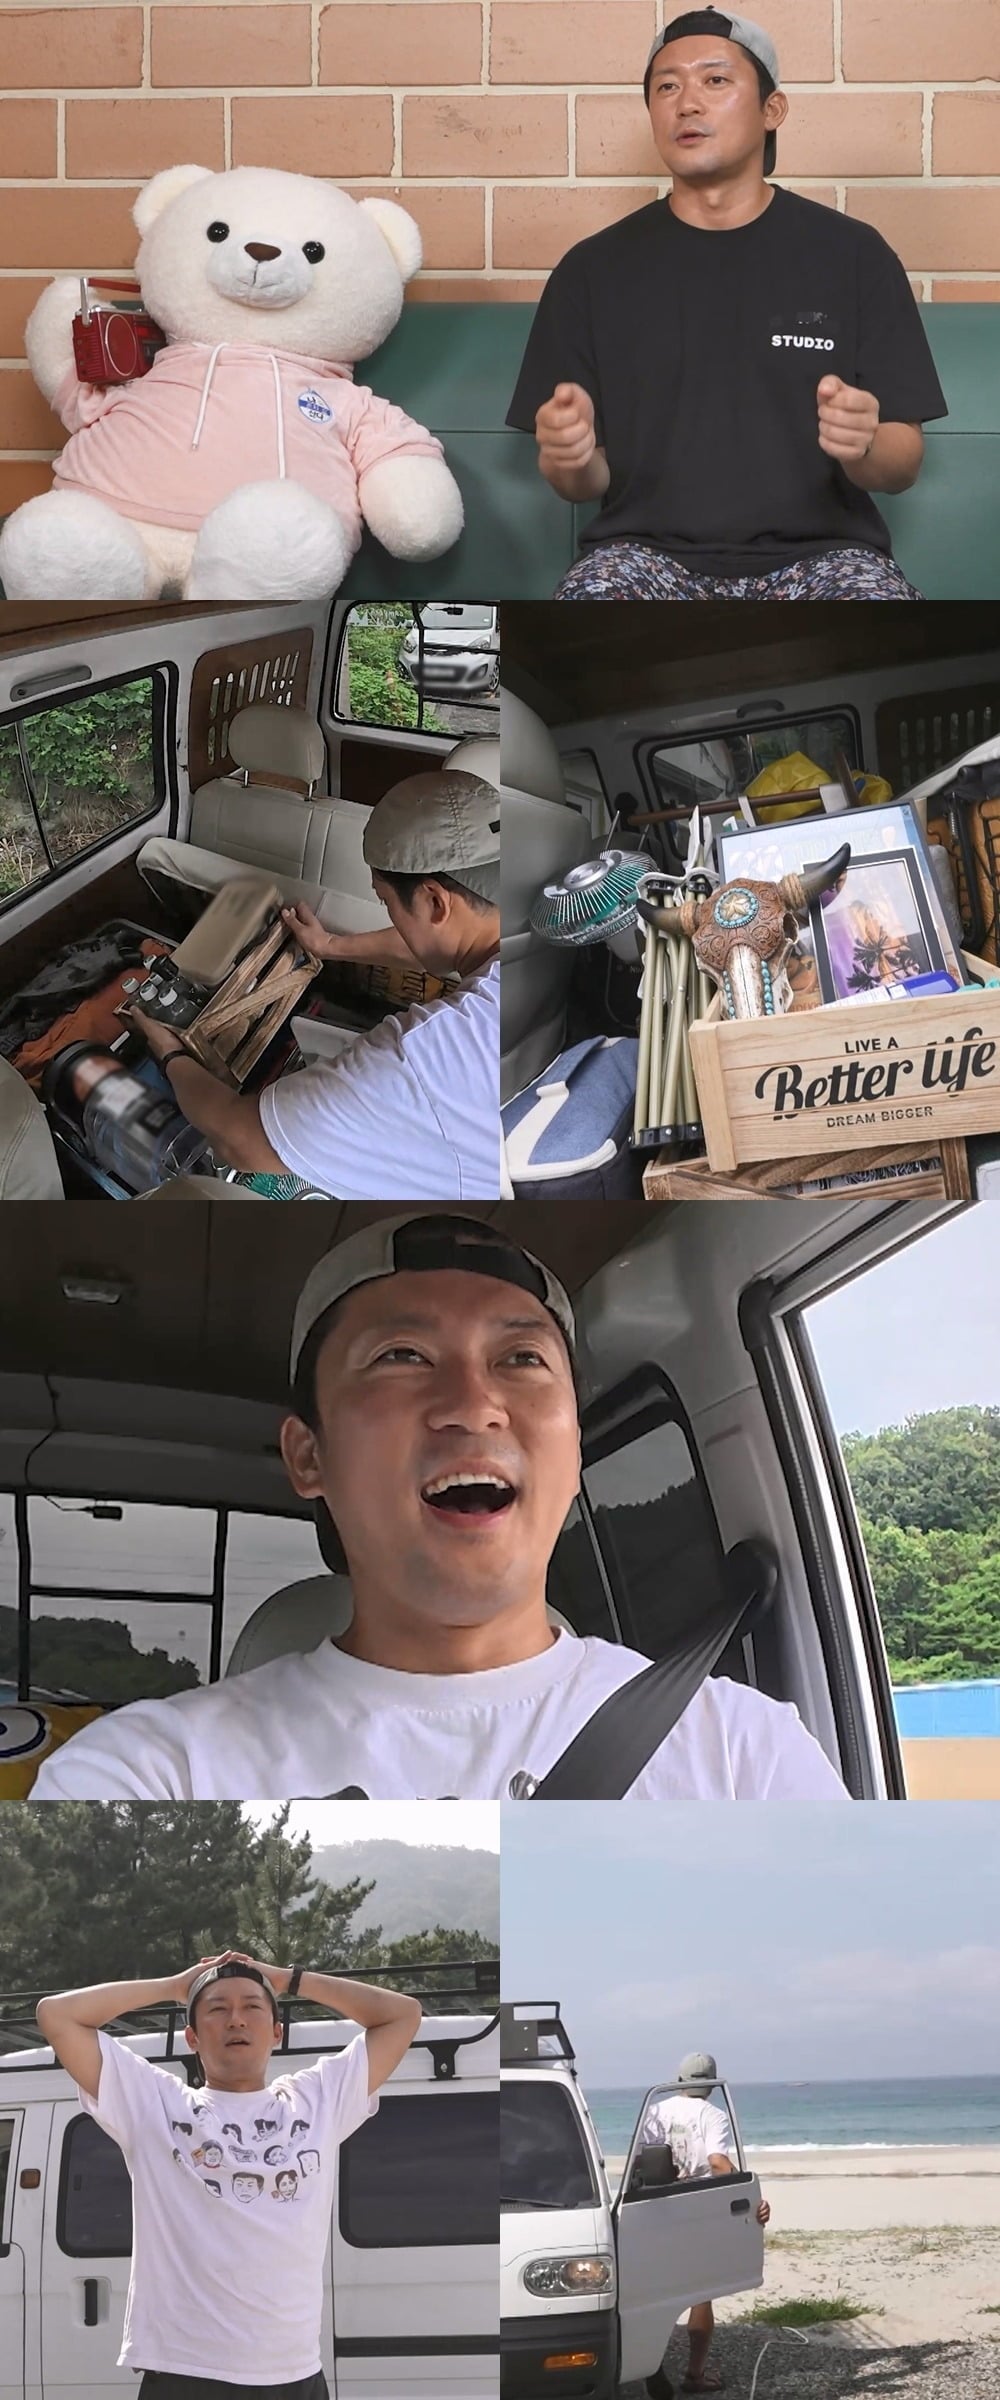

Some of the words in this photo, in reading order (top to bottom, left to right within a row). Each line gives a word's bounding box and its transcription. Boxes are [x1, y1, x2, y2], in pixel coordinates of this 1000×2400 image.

[771, 335, 834, 351] STUDIO
[845, 1039, 881, 1053] LIVE
[887, 1036, 899, 1049] A
[755, 1060, 913, 1121] Better
[826, 1112, 876, 1128] DREAM
[881, 1106, 933, 1122] BIGGER
